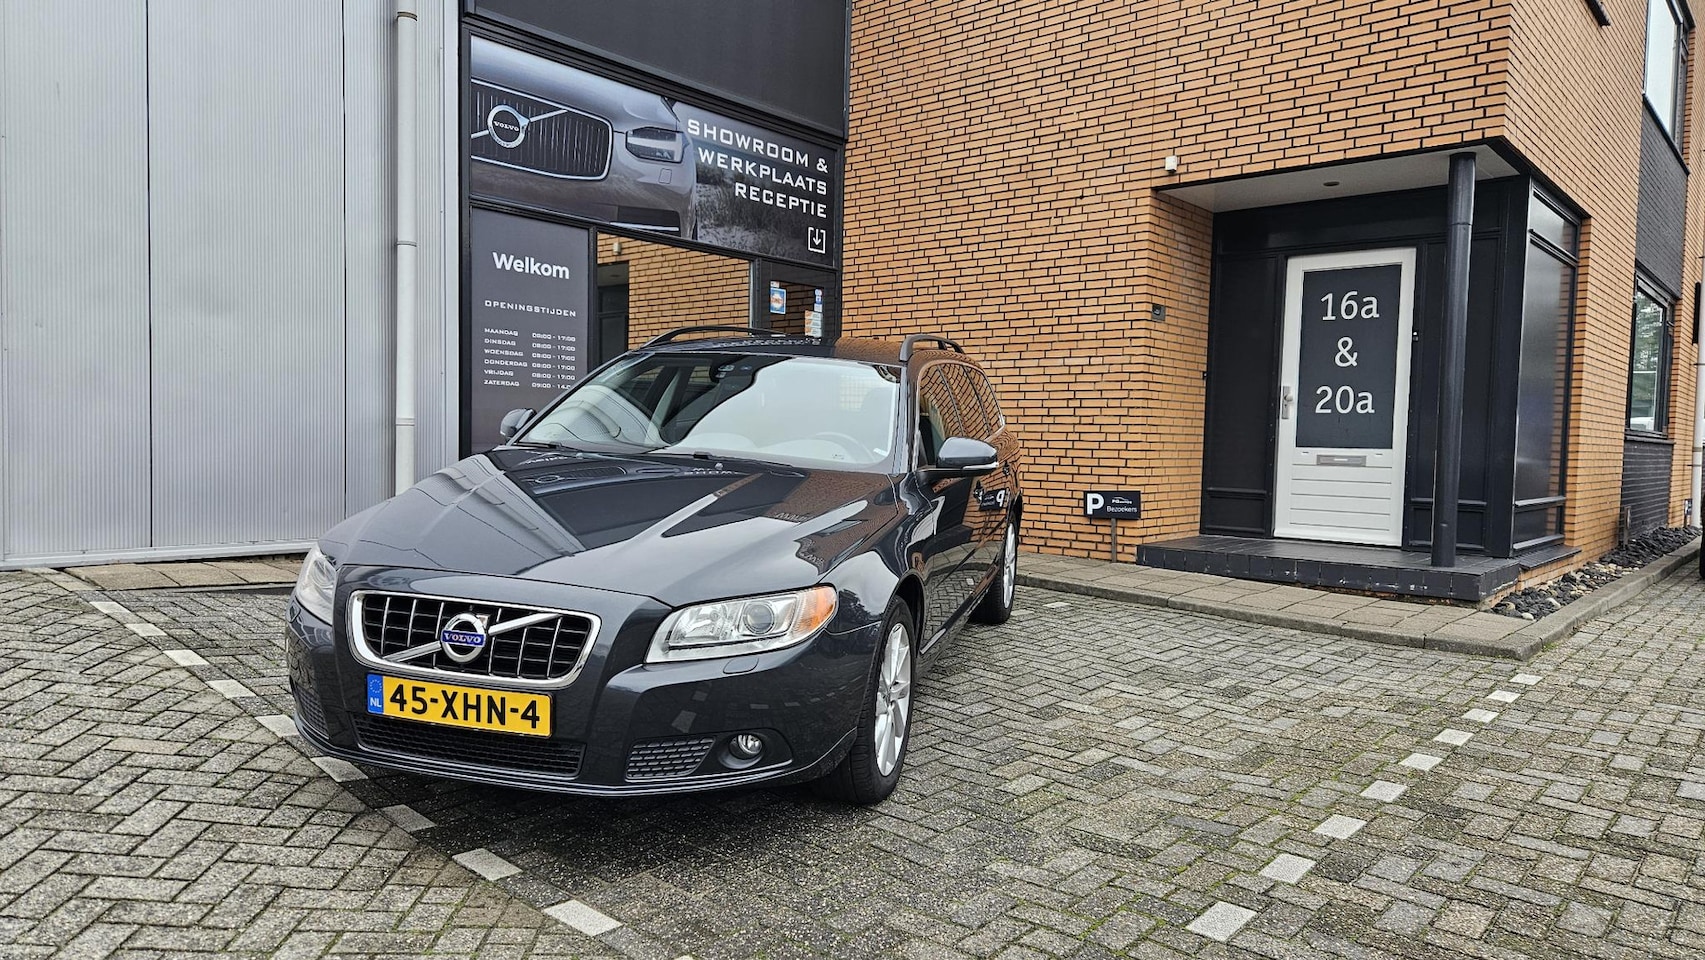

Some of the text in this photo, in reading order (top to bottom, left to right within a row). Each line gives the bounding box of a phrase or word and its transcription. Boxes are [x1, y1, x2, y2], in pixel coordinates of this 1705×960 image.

[493, 120, 520, 132] VOLVO
[687, 118, 829, 174] SHOWROOM &
[698, 147, 828, 196] WERKPLAATS
[735, 182, 828, 219] RECEPTIE
[492, 251, 570, 280] Welkom
[484, 299, 577, 317] OPENINGSTIJDEN
[1320, 290, 1380, 321] 16a
[484, 328, 519, 337] MAANDAG
[484, 338, 516, 346] DINSDAG
[484, 348, 524, 357] WOENSDAG
[1334, 336, 1358, 368] &
[484, 359, 528, 367] DONDERDAG
[484, 369, 514, 377] VRIJDAG
[1315, 385, 1376, 414] 20a
[1086, 493, 1104, 515] P
[1106, 505, 1138, 513] Bezoekers
[443, 632, 482, 645] VOLVO
[370, 697, 382, 708] NL
[389, 683, 540, 729] 45-XHN-4
